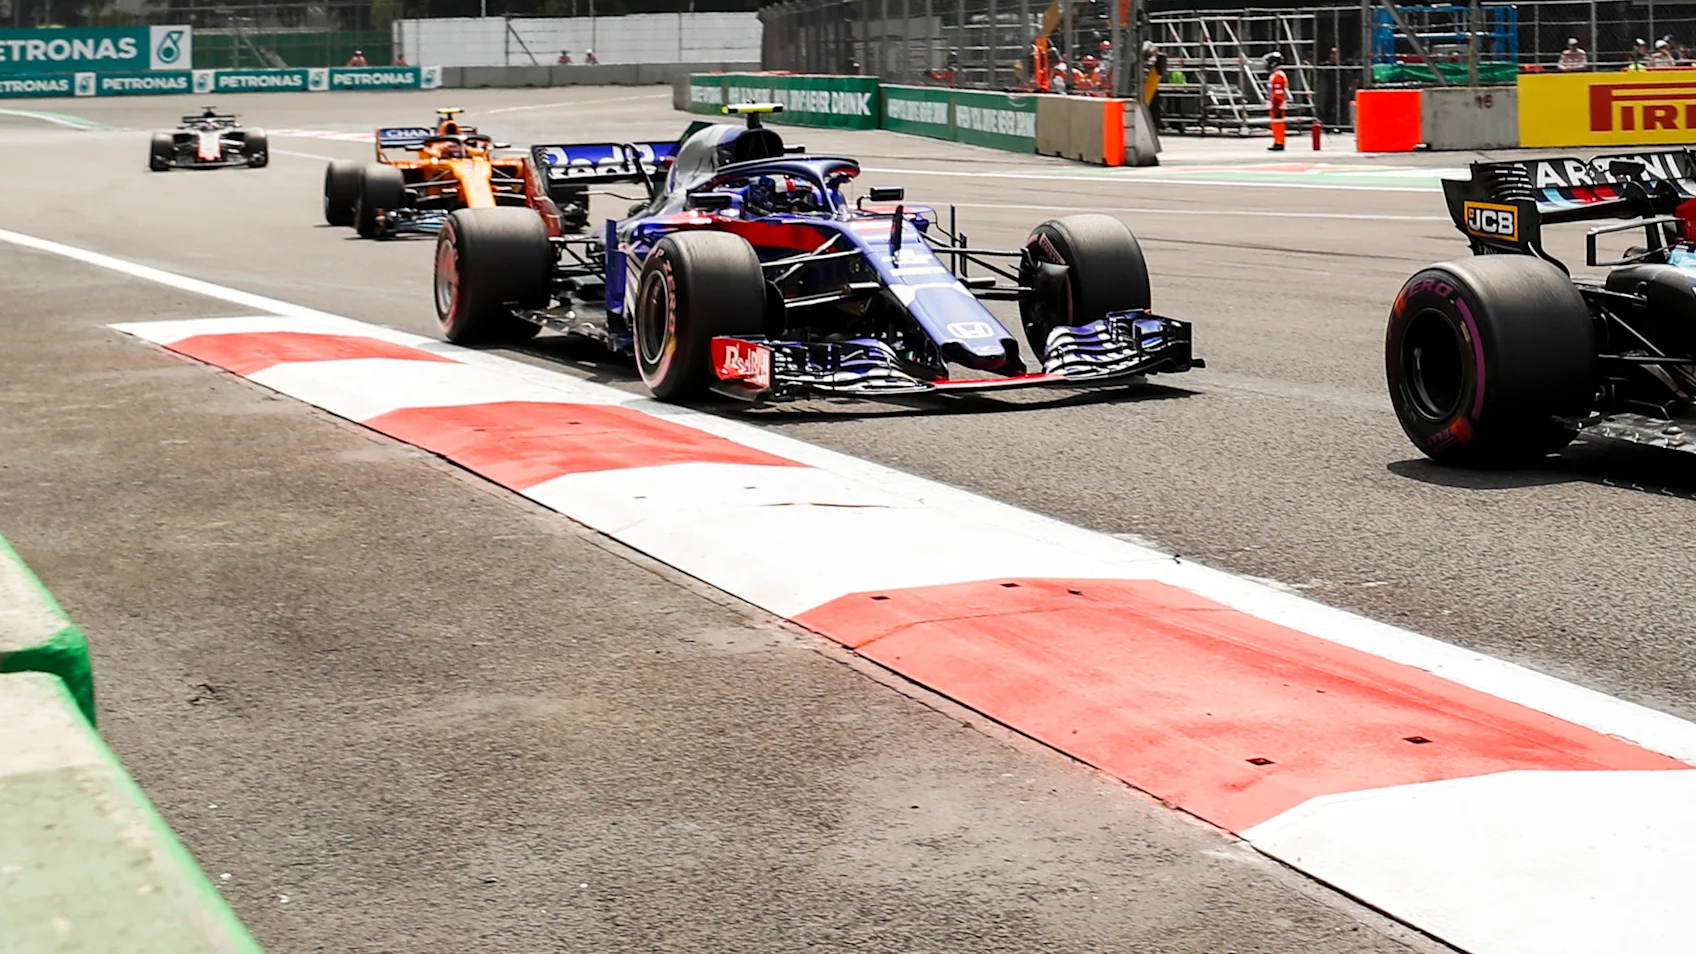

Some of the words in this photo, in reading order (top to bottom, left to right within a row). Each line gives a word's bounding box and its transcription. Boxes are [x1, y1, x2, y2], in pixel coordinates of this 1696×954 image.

[102, 77, 188, 90] PETRONAS
[218, 75, 303, 88] PETRONAS
[332, 73, 415, 86] PETRONAS
[1475, 94, 1494, 110] 16
[383, 128, 436, 138] CHAN
[1468, 207, 1515, 236] JCB
